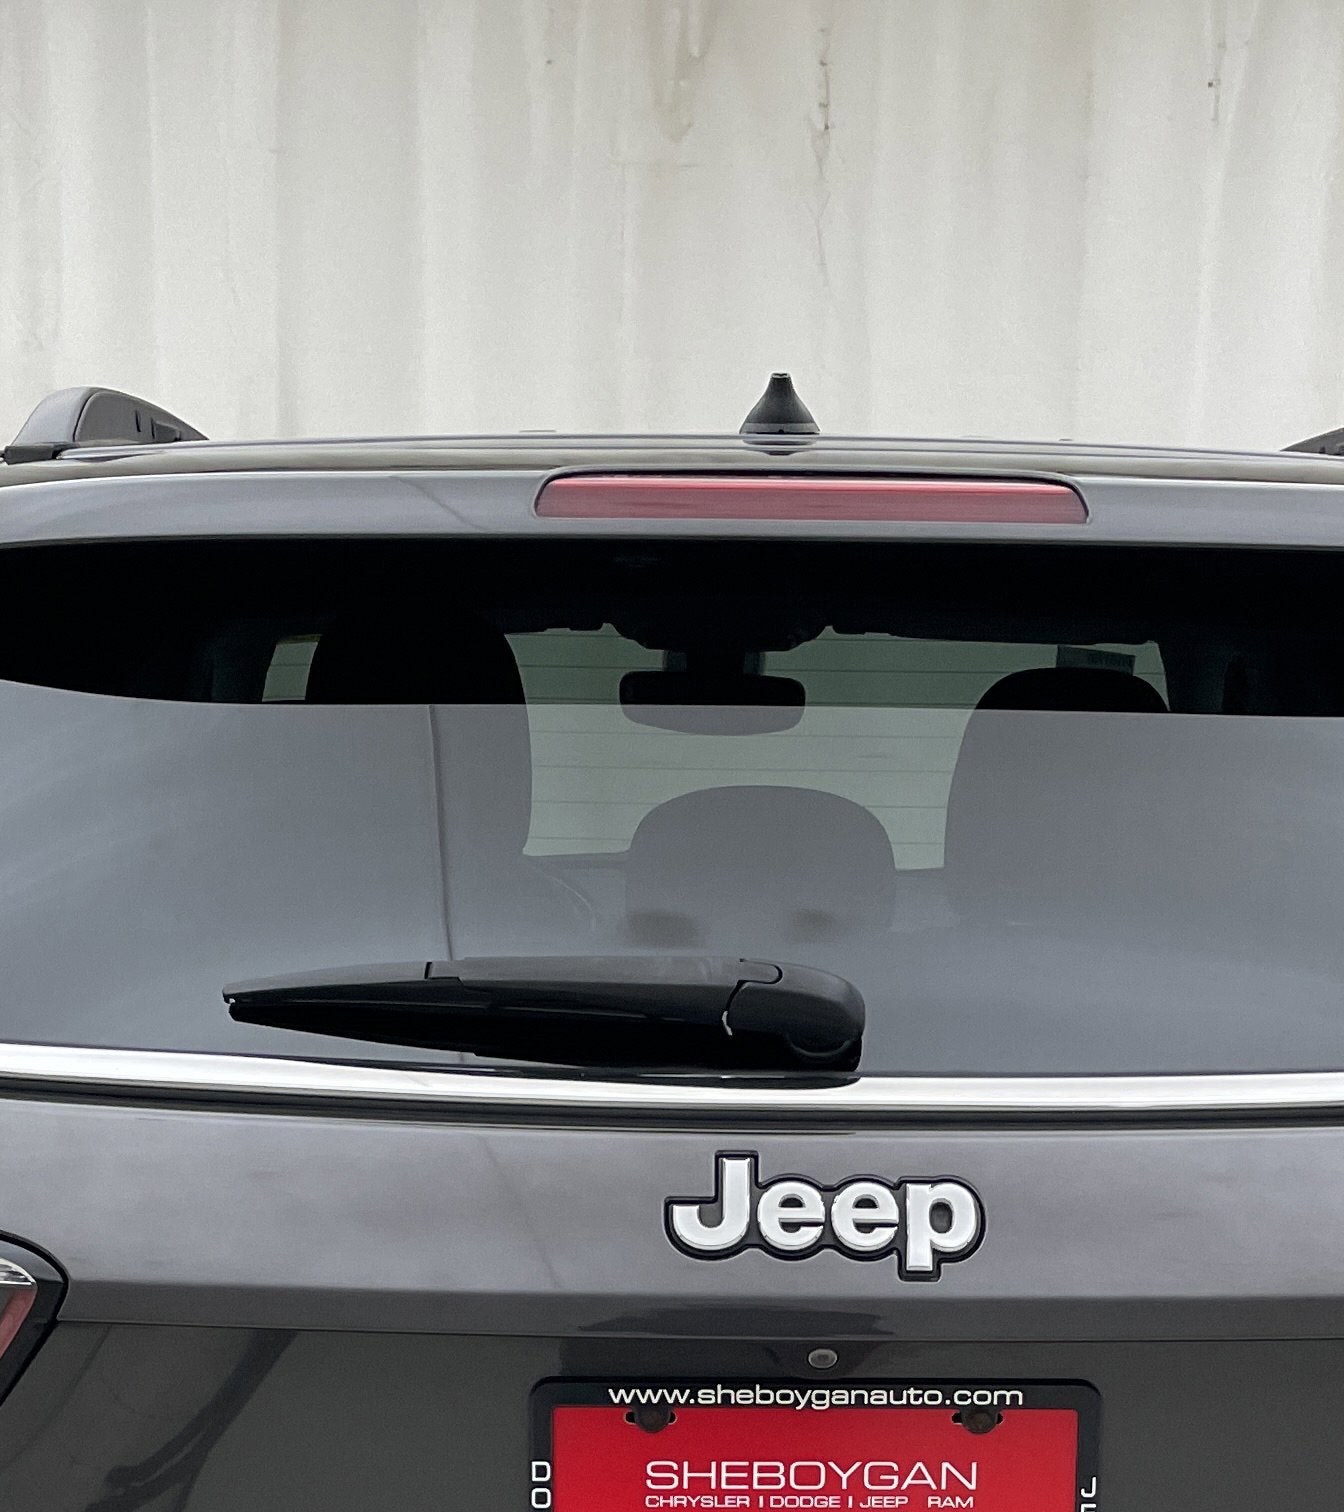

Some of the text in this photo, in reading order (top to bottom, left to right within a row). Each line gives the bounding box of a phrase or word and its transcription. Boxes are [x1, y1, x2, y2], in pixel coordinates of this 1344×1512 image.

[670, 1155, 979, 1274] Jeep
[608, 1384, 1024, 1410] www.sheboyganauto.com
[645, 1461, 977, 1491] SHEBOYGAN
[645, 1495, 974, 1508] CHRYSLER DODGE JEEP RAM
